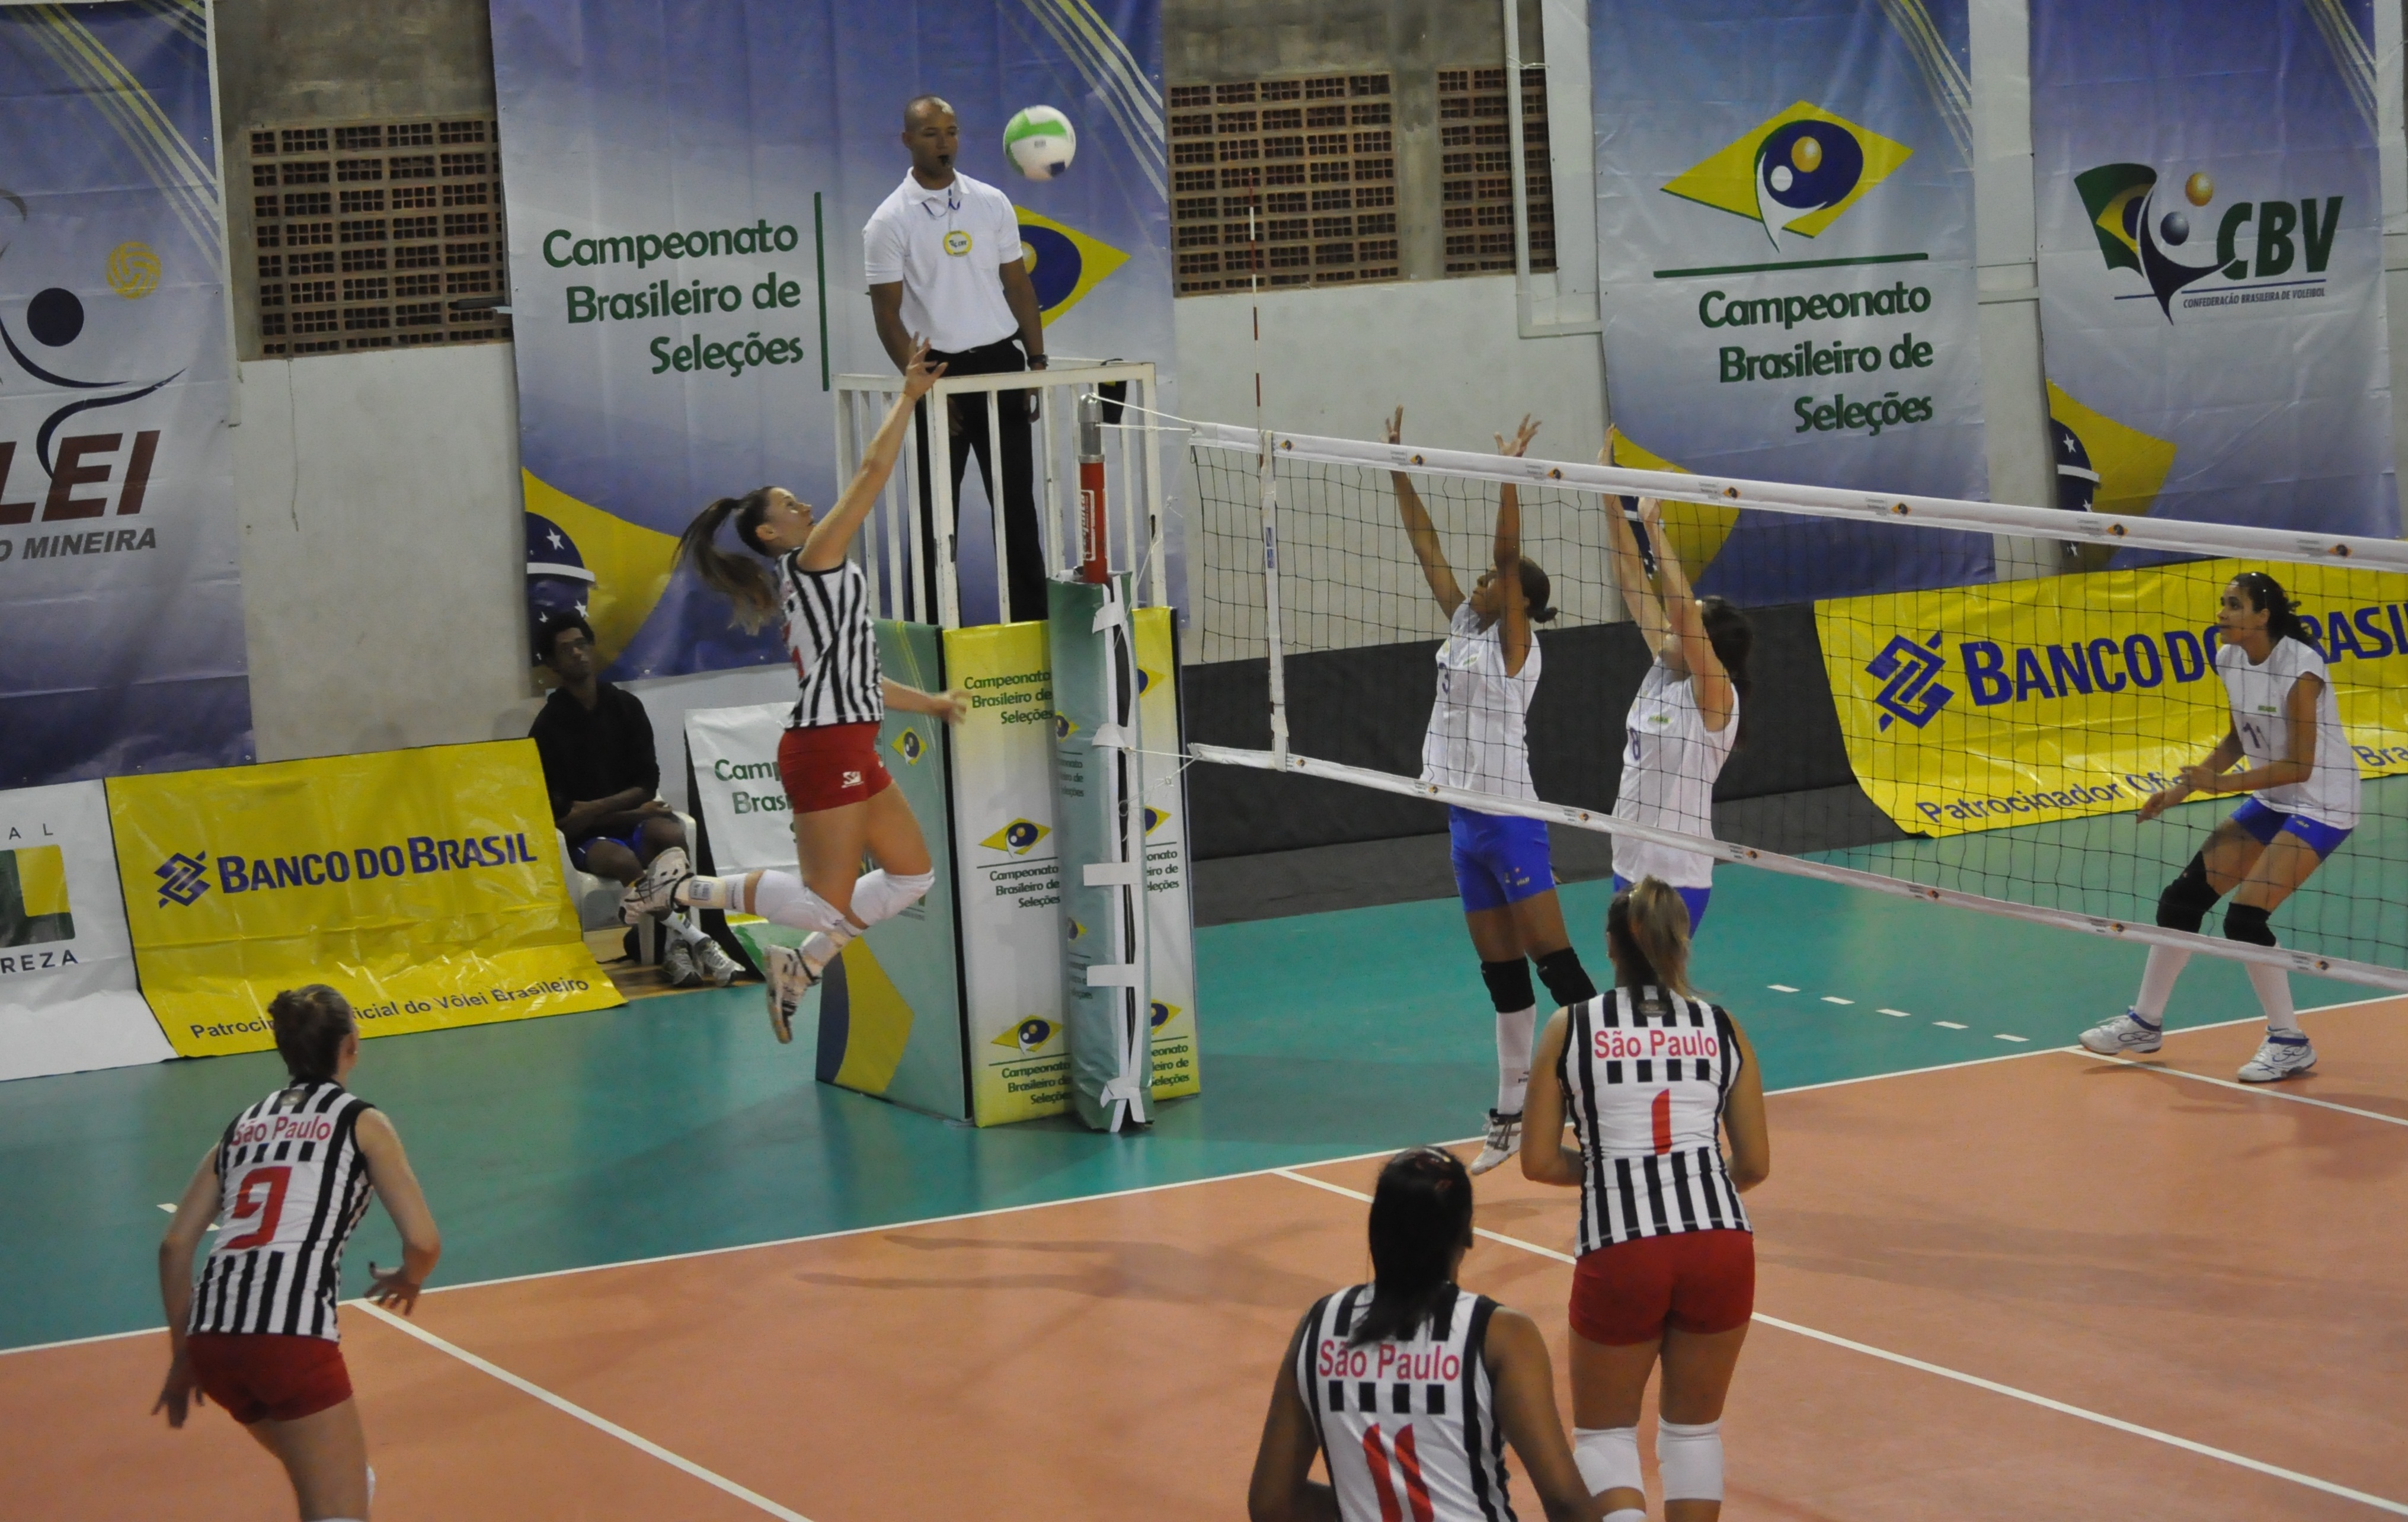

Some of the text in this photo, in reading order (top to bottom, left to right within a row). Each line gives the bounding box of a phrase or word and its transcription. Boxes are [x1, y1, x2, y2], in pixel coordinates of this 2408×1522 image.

[543, 219, 798, 269] Campeonato
[2217, 196, 2343, 280] CBV
[566, 271, 801, 324] Brasileiro de
[1699, 281, 1931, 330] Campeonato
[2281, 290, 2291, 300] DE
[650, 332, 804, 378] Seleções
[1719, 332, 1933, 383] Brasileiro de
[1793, 391, 1933, 436] Seleções
[22, 527, 156, 559] MINEIRA
[964, 670, 1052, 690] Campeonato
[1959, 633, 2164, 707] BANCO
[972, 688, 1053, 708] Brasileiro de
[1000, 709, 1053, 725] Seleções
[1630, 727, 1640, 760] 8
[1917, 782, 2122, 823] Patrocinador
[217, 833, 537, 894] BANCO DO BRASIL
[989, 865, 1059, 881] Campeonato
[1165, 864, 1179, 874] de
[996, 879, 1060, 896] Brasileiro de
[1018, 895, 1060, 909] Seleções
[404, 1000, 431, 1015] do
[433, 991, 487, 1009] Vôlei
[491, 977, 589, 1002] Brasileiro
[1176, 1057, 1189, 1068] de
[1594, 1029, 1718, 1059] São Paulo
[1008, 1079, 1056, 1093] Brasileiro
[231, 1115, 331, 1146] São Paulo
[1652, 1089, 1672, 1155] 1
[222, 1166, 292, 1249] 9
[1319, 1340, 1460, 1381] São Paulo
[1363, 1423, 1434, 1522] 11
